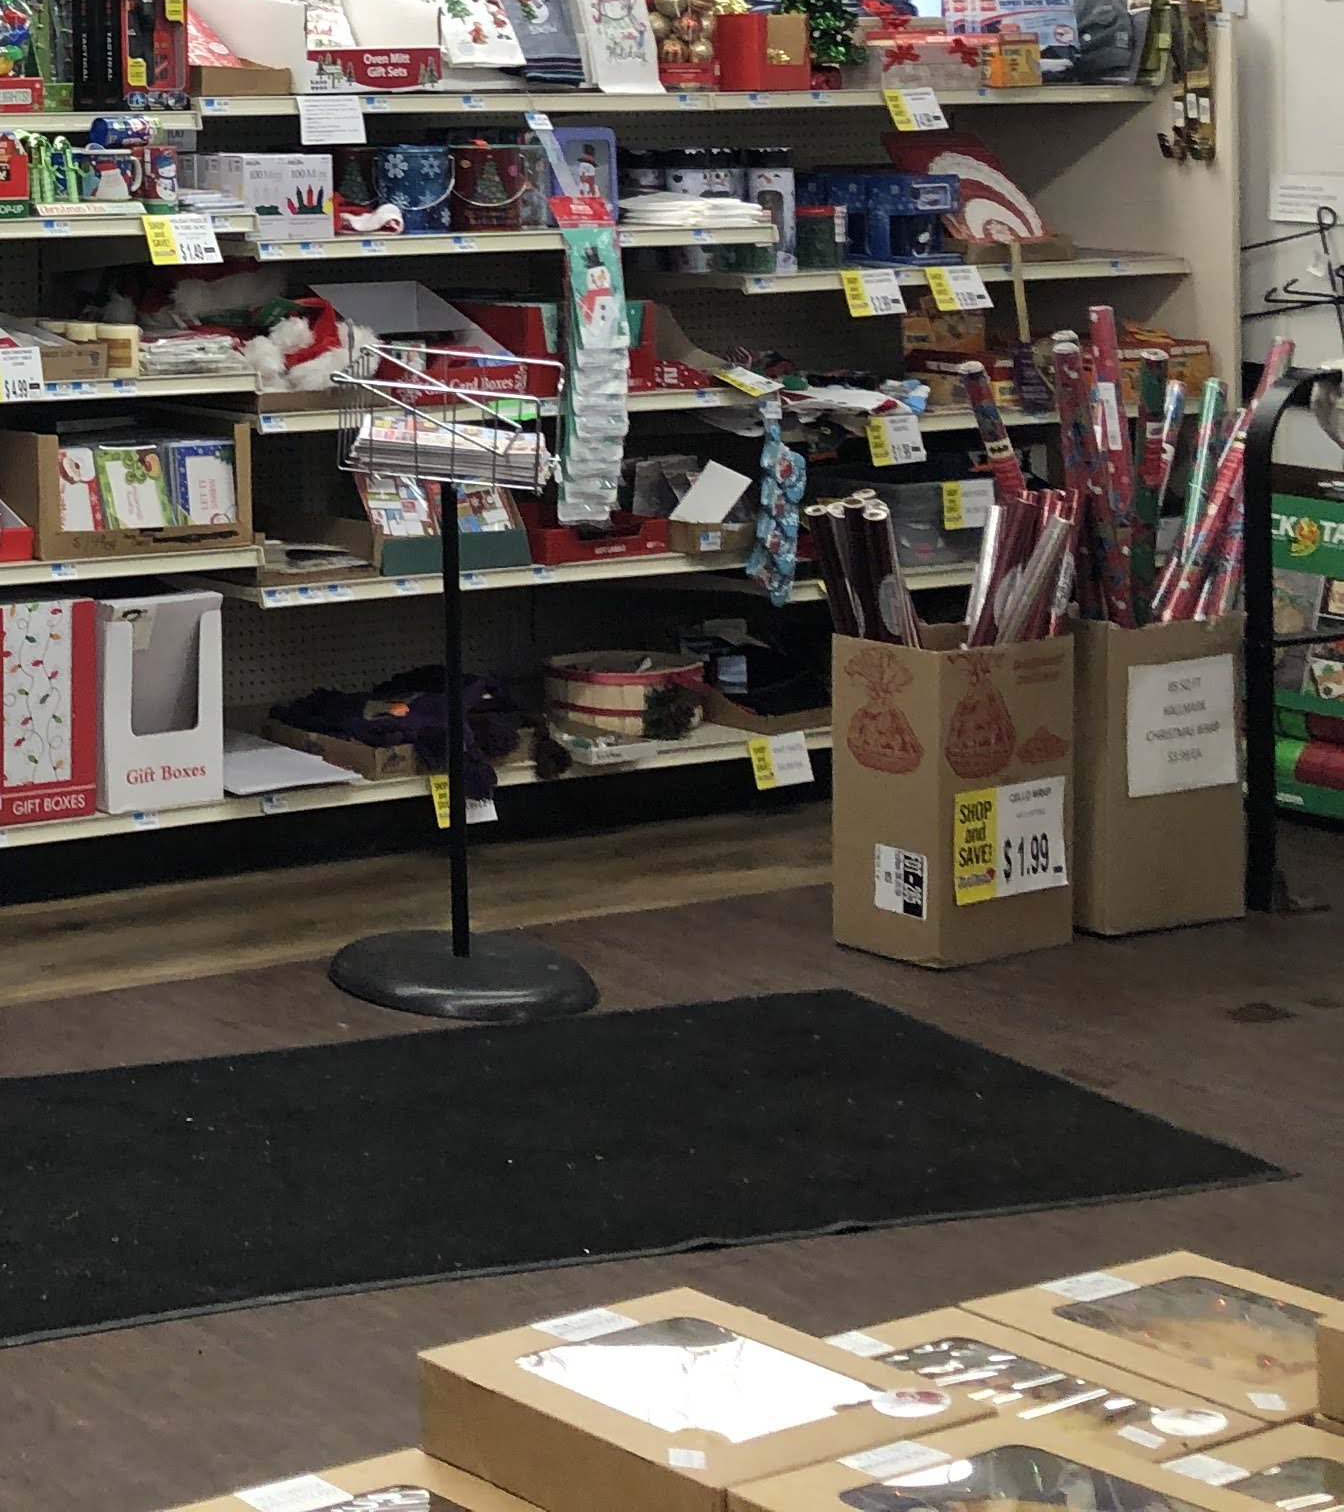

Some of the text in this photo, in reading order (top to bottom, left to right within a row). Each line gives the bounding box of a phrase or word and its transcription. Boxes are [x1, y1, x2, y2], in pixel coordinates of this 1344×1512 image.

[363, 52, 411, 65] Oven Mitt
[367, 65, 409, 78] Gift Sets
[450, 375, 515, 393] Card Boxes
[1320, 521, 1344, 543] TA
[126, 764, 207, 785] Gift Boxes
[12, 794, 86, 816] GIFT BOXES
[959, 800, 992, 824] SHOP
[965, 821, 986, 844] and
[959, 843, 993, 868] SAVE!
[1003, 832, 1050, 884] $1.99
